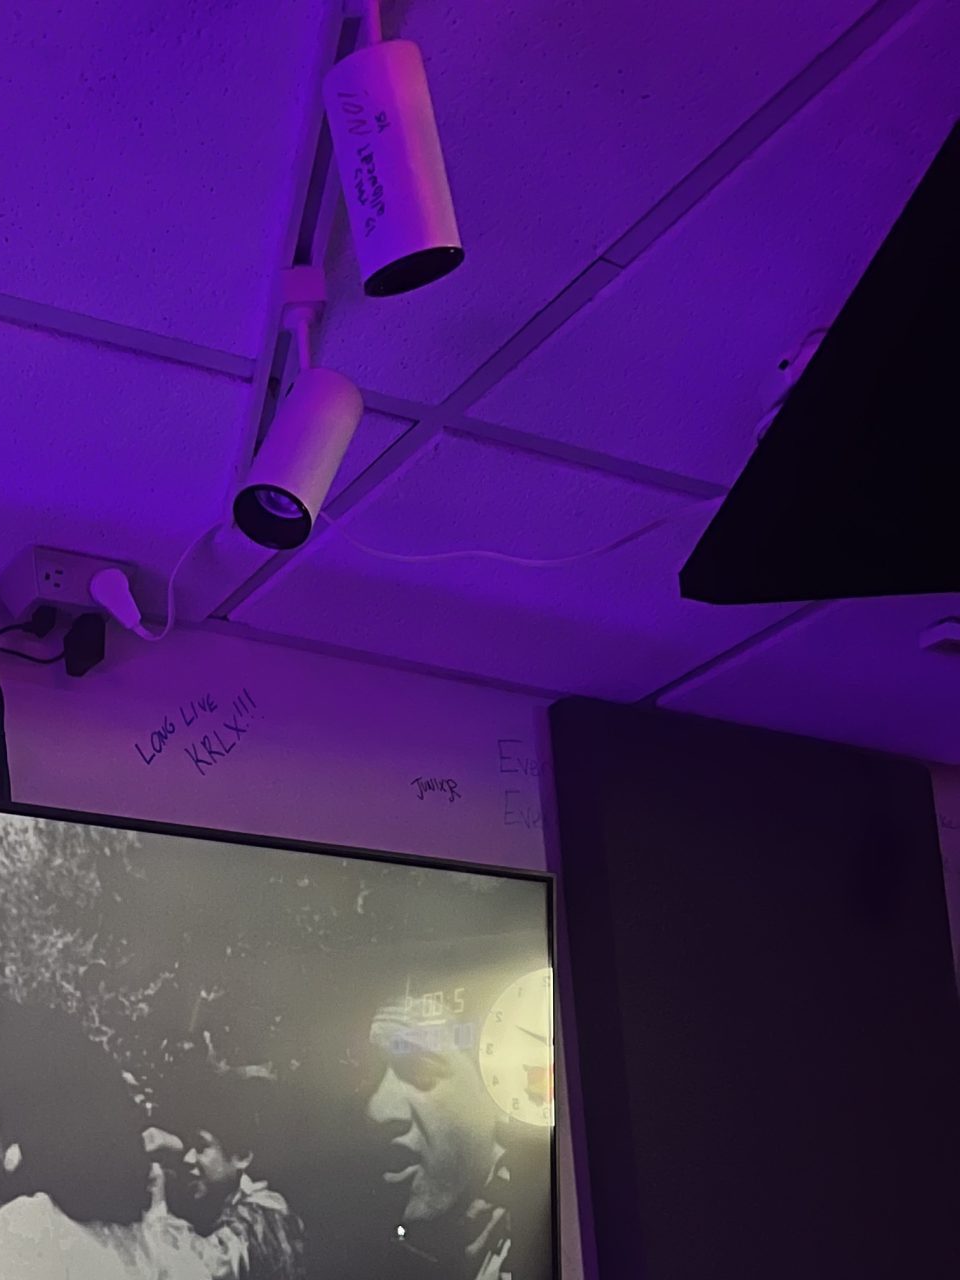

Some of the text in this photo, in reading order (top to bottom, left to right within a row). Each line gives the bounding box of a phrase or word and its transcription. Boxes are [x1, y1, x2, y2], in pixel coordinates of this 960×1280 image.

[134, 693, 219, 765] LONG LIVE
[183, 687, 266, 776] KRLX!!!
